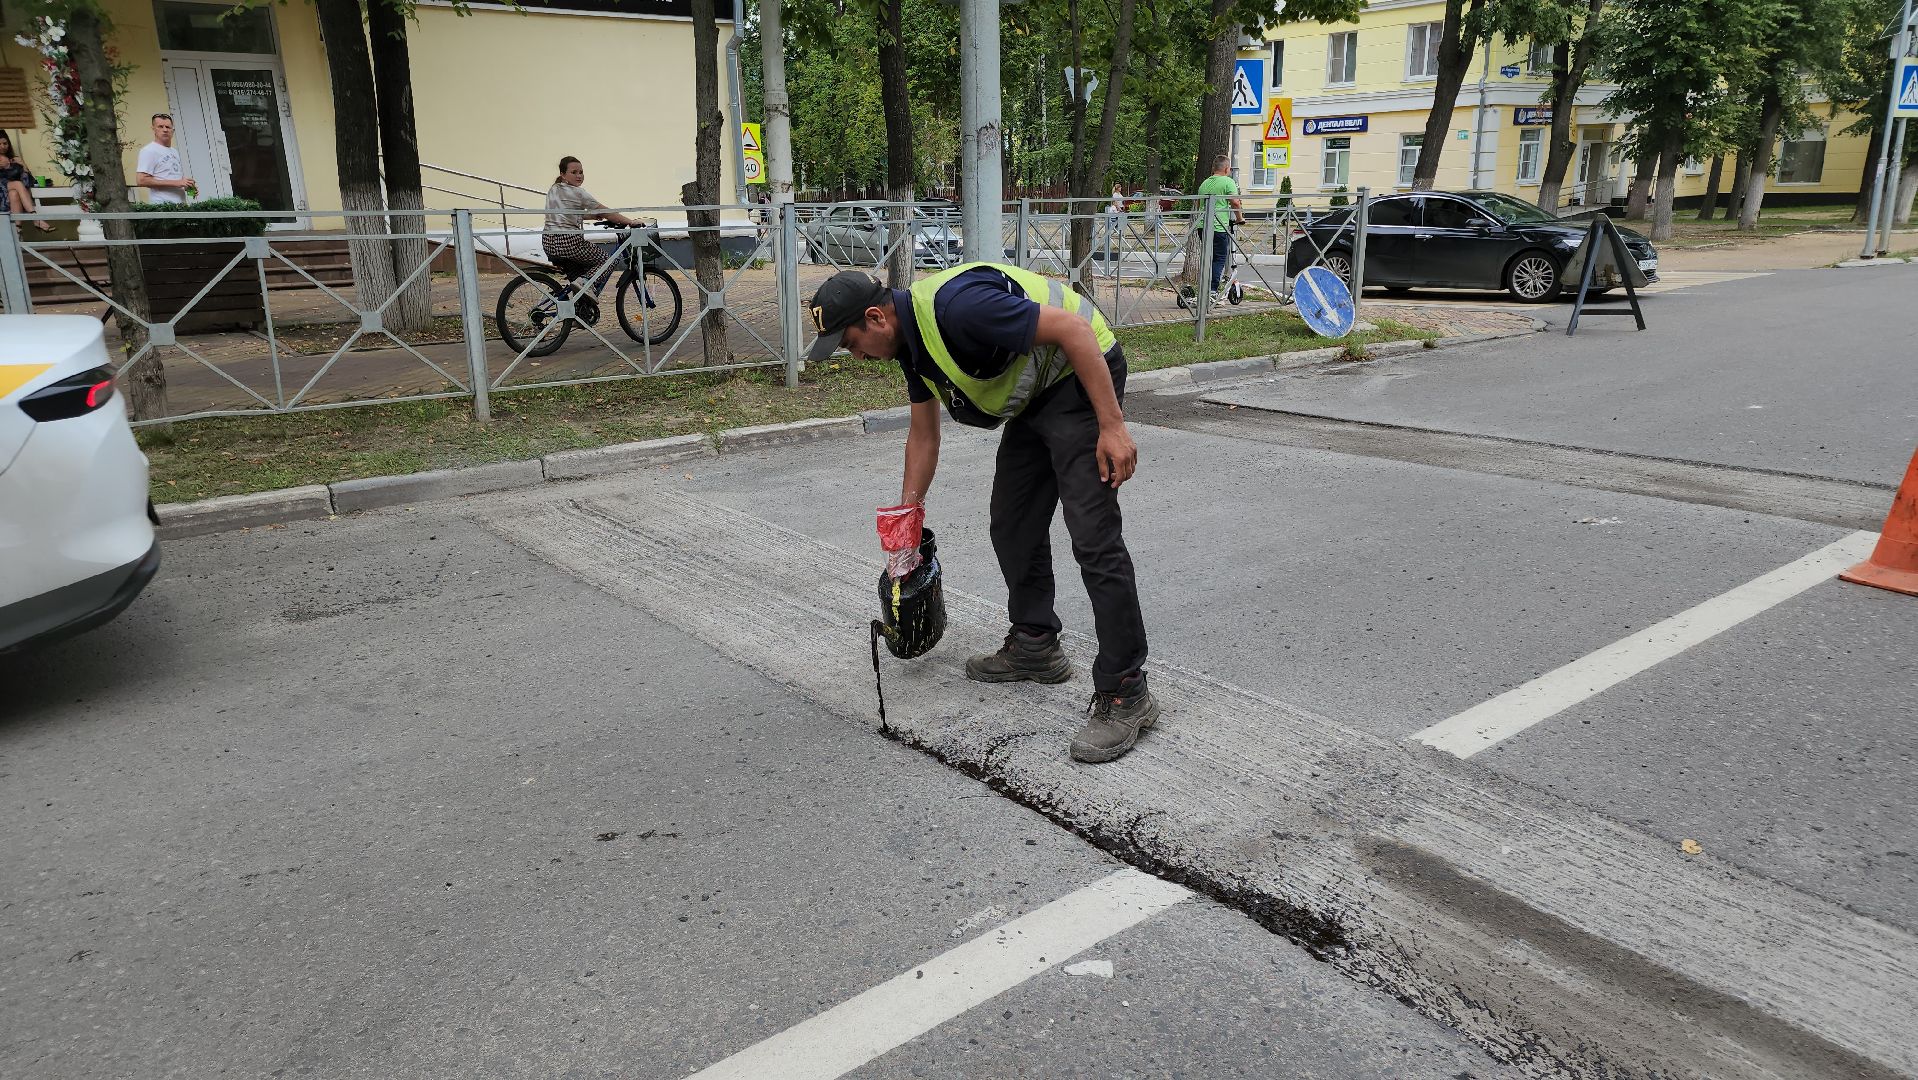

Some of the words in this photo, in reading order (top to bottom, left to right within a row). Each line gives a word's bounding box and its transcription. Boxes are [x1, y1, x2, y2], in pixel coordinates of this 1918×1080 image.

[1317, 120, 1345, 130] ДЕНТАЛ
[1344, 119, 1363, 127] ВЕЛЛ
[745, 163, 757, 173] 40
